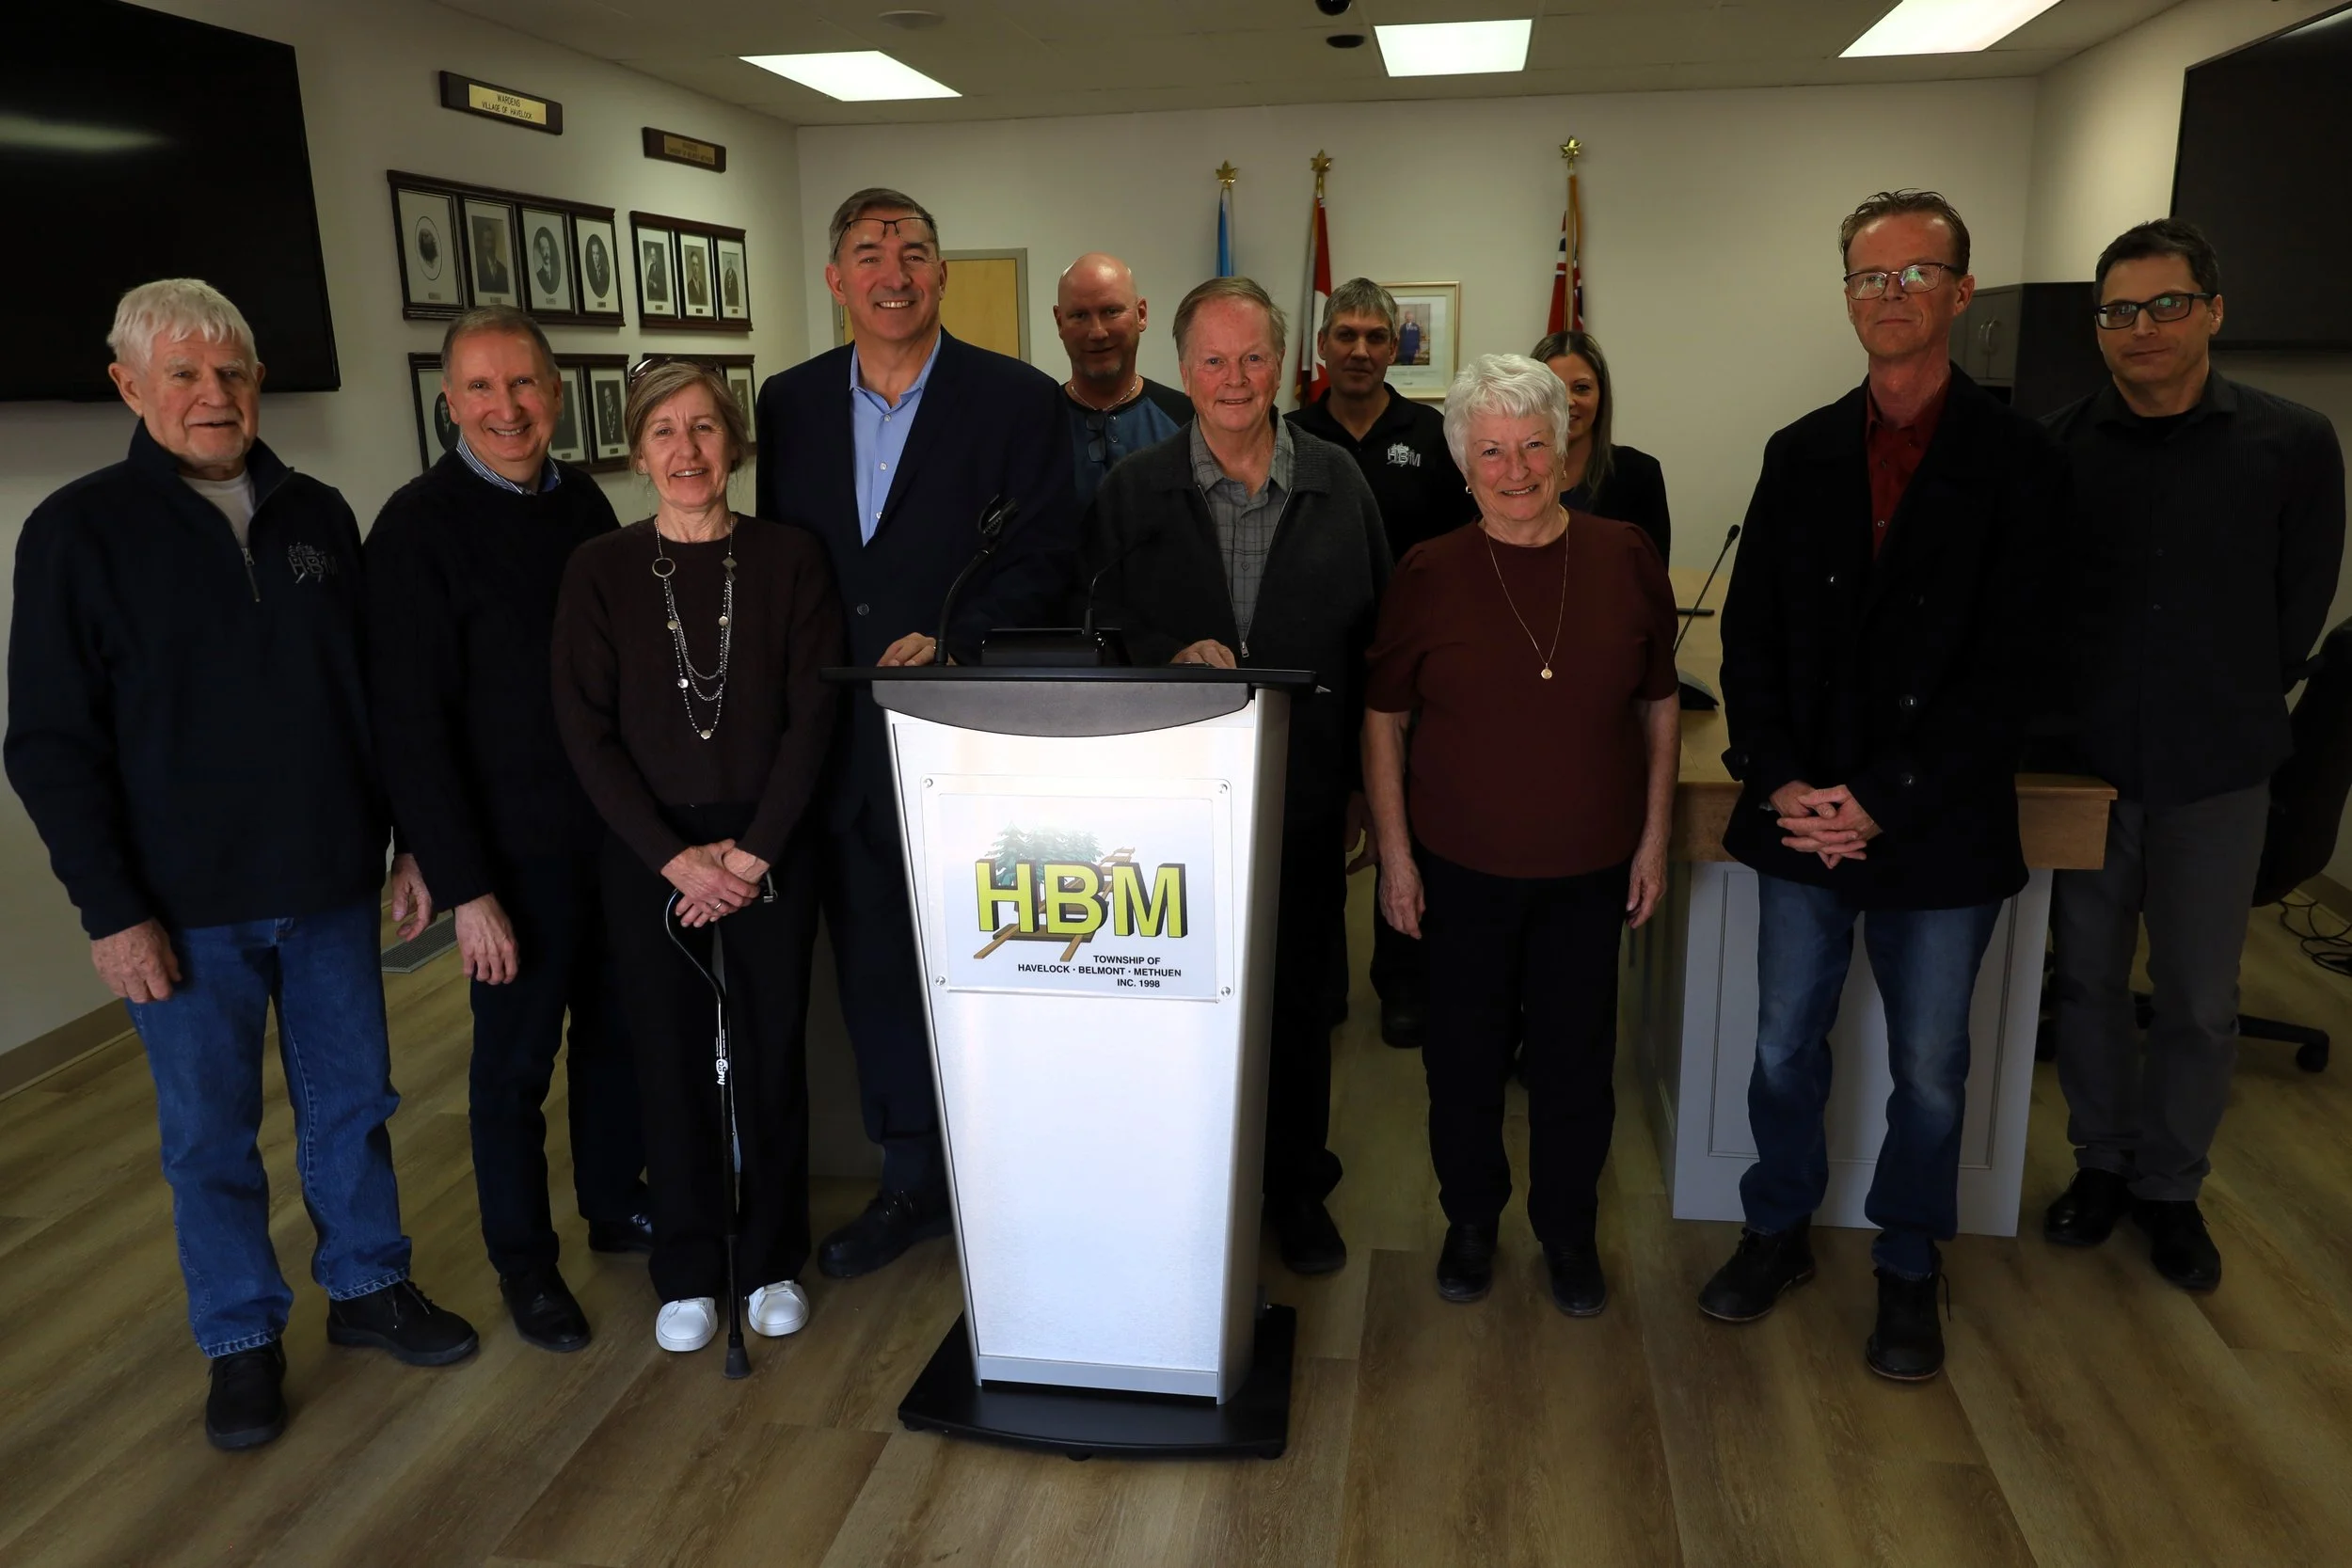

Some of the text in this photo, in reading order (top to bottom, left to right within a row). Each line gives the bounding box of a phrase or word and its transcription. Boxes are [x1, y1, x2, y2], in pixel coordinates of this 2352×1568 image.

[482, 102, 501, 112] VILLAGE
[497, 94, 520, 107] WARDENS
[1387, 448, 1422, 467] HBM
[975, 858, 1188, 939] HBM
[1092, 955, 1161, 965] TOWNSHIP OF
[1018, 963, 1182, 977] HAVELOCK BELMONT METHUEN
[1117, 978, 1160, 989] INC. 1998
